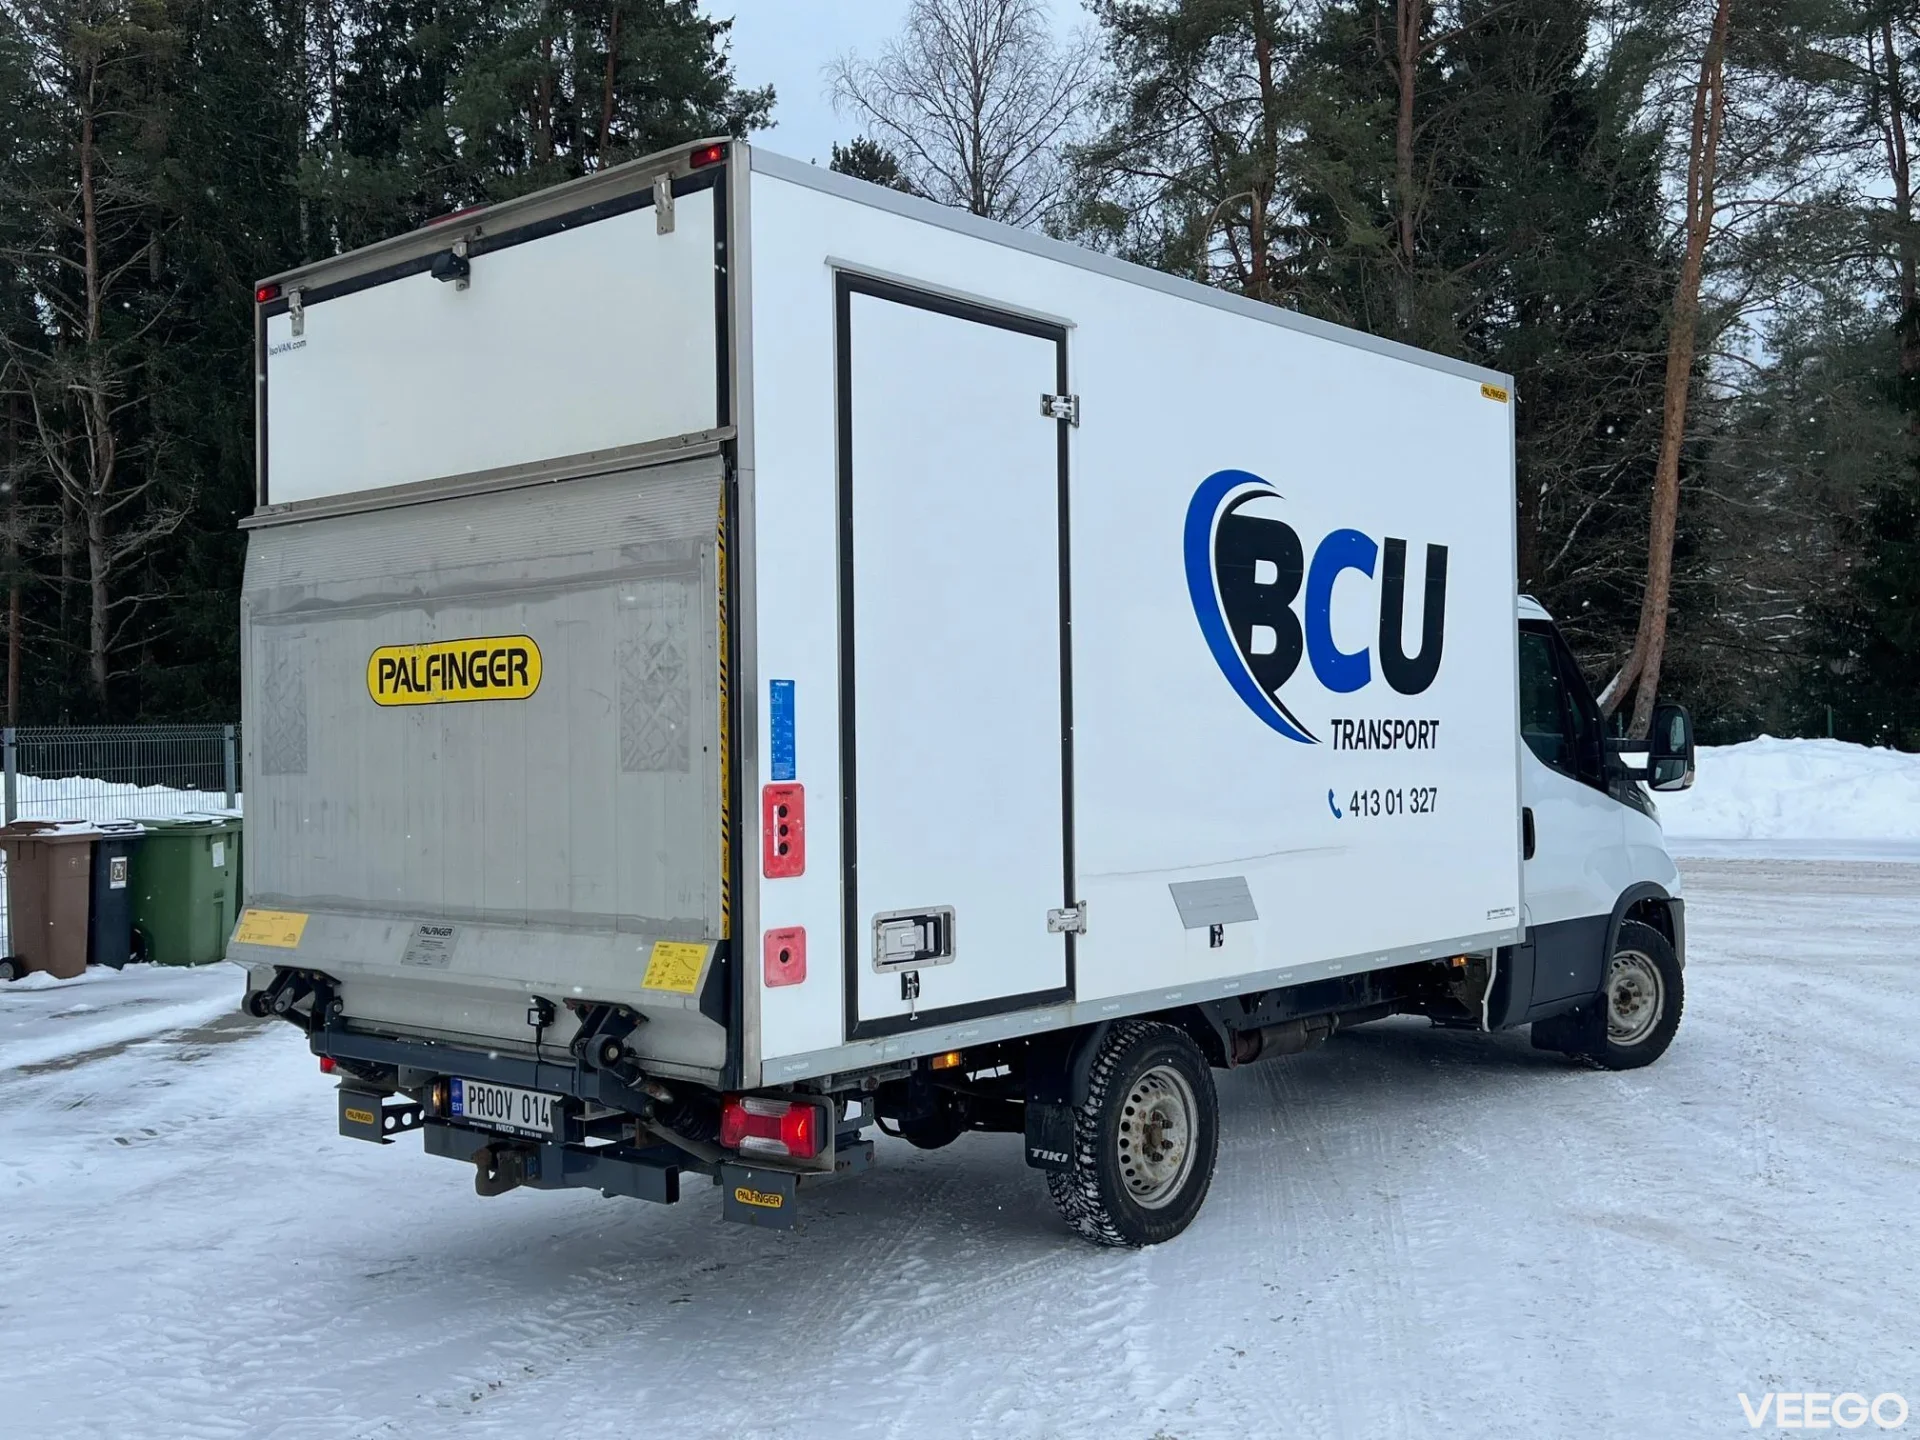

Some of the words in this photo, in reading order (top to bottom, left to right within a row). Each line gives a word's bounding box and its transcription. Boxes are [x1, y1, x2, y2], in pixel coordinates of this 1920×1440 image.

[1214, 510, 1449, 696] BCU
[378, 648, 529, 694] PALFINGER
[1331, 719, 1440, 750] TRANSPORT
[1349, 789, 1381, 817] 413
[1385, 788, 1403, 815] 01
[1410, 787, 1438, 814] 327
[452, 1102, 463, 1112] EST
[468, 1085, 513, 1121] PROOV
[522, 1094, 550, 1128] 014
[496, 1123, 515, 1134] IVECO
[1030, 1148, 1069, 1163] TIKI
[737, 1190, 780, 1206] PALFINGER
